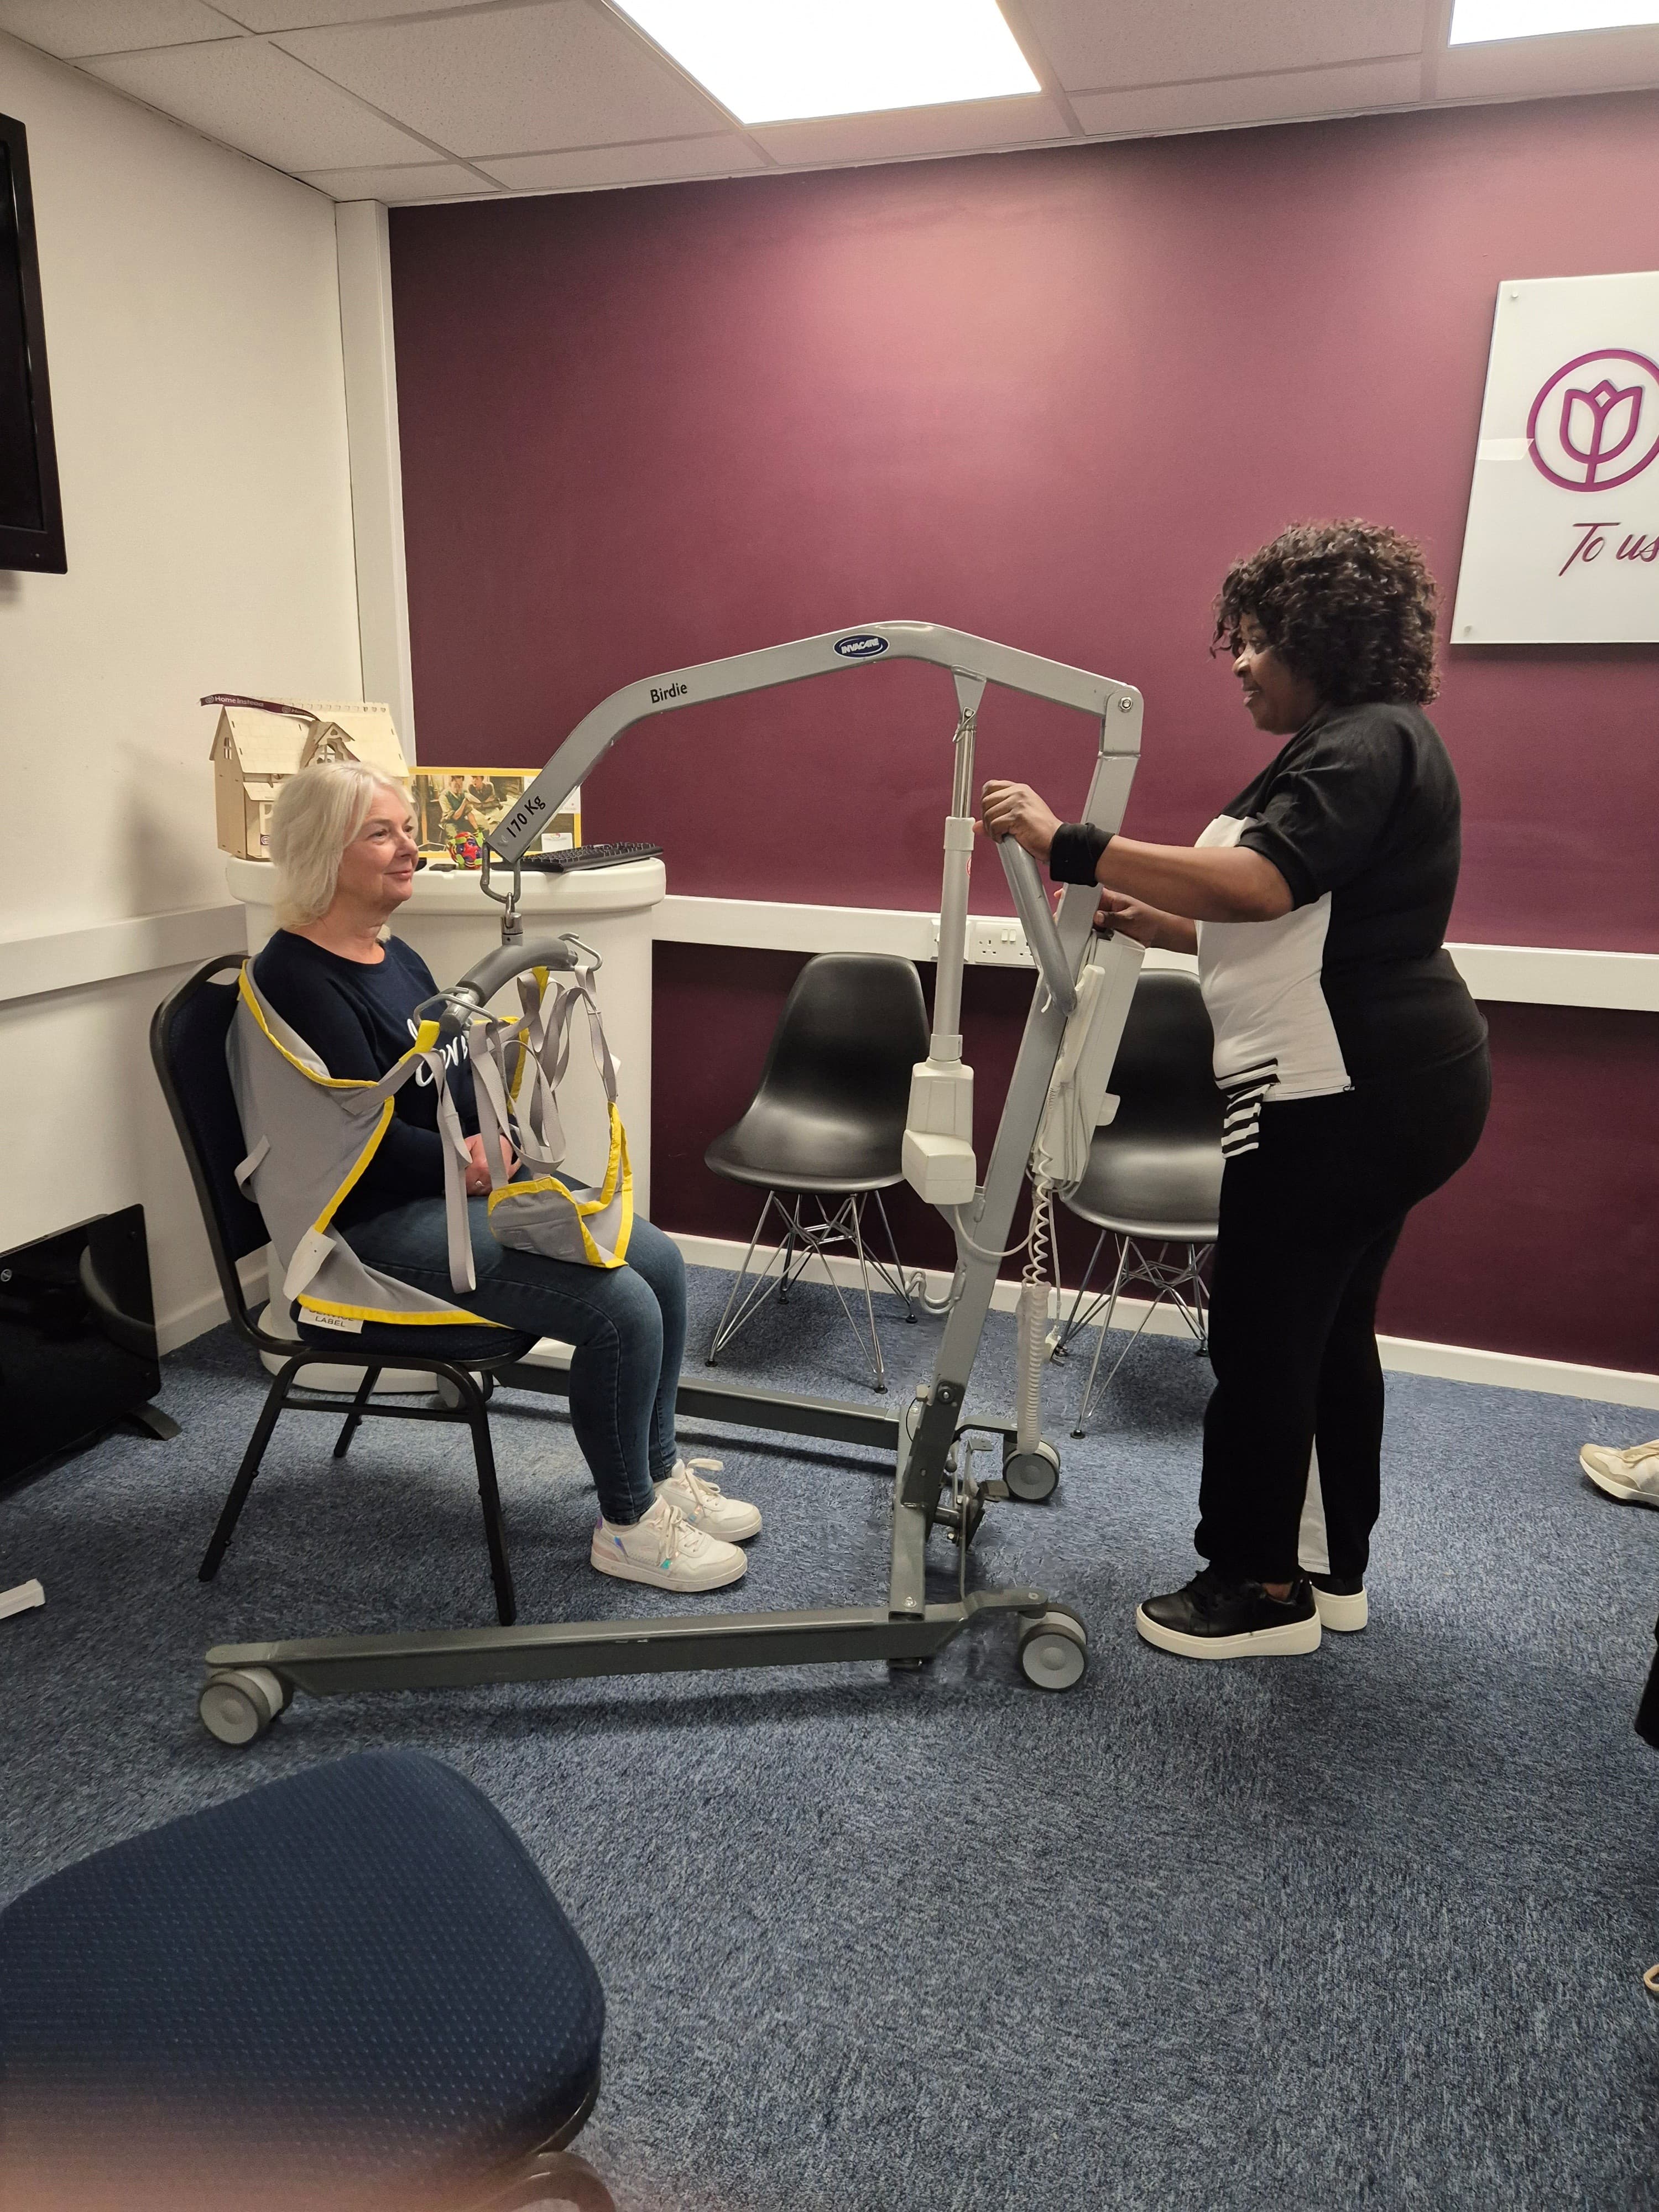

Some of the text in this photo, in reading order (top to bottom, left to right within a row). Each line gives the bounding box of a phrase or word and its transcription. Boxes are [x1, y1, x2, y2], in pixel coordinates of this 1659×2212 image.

[1558, 522, 1621, 576] To
[841, 638, 879, 654] INVACARE
[650, 682, 687, 703] Birdie
[507, 796, 546, 838] 170 Kg
[315, 1316, 346, 1327] LABEL
